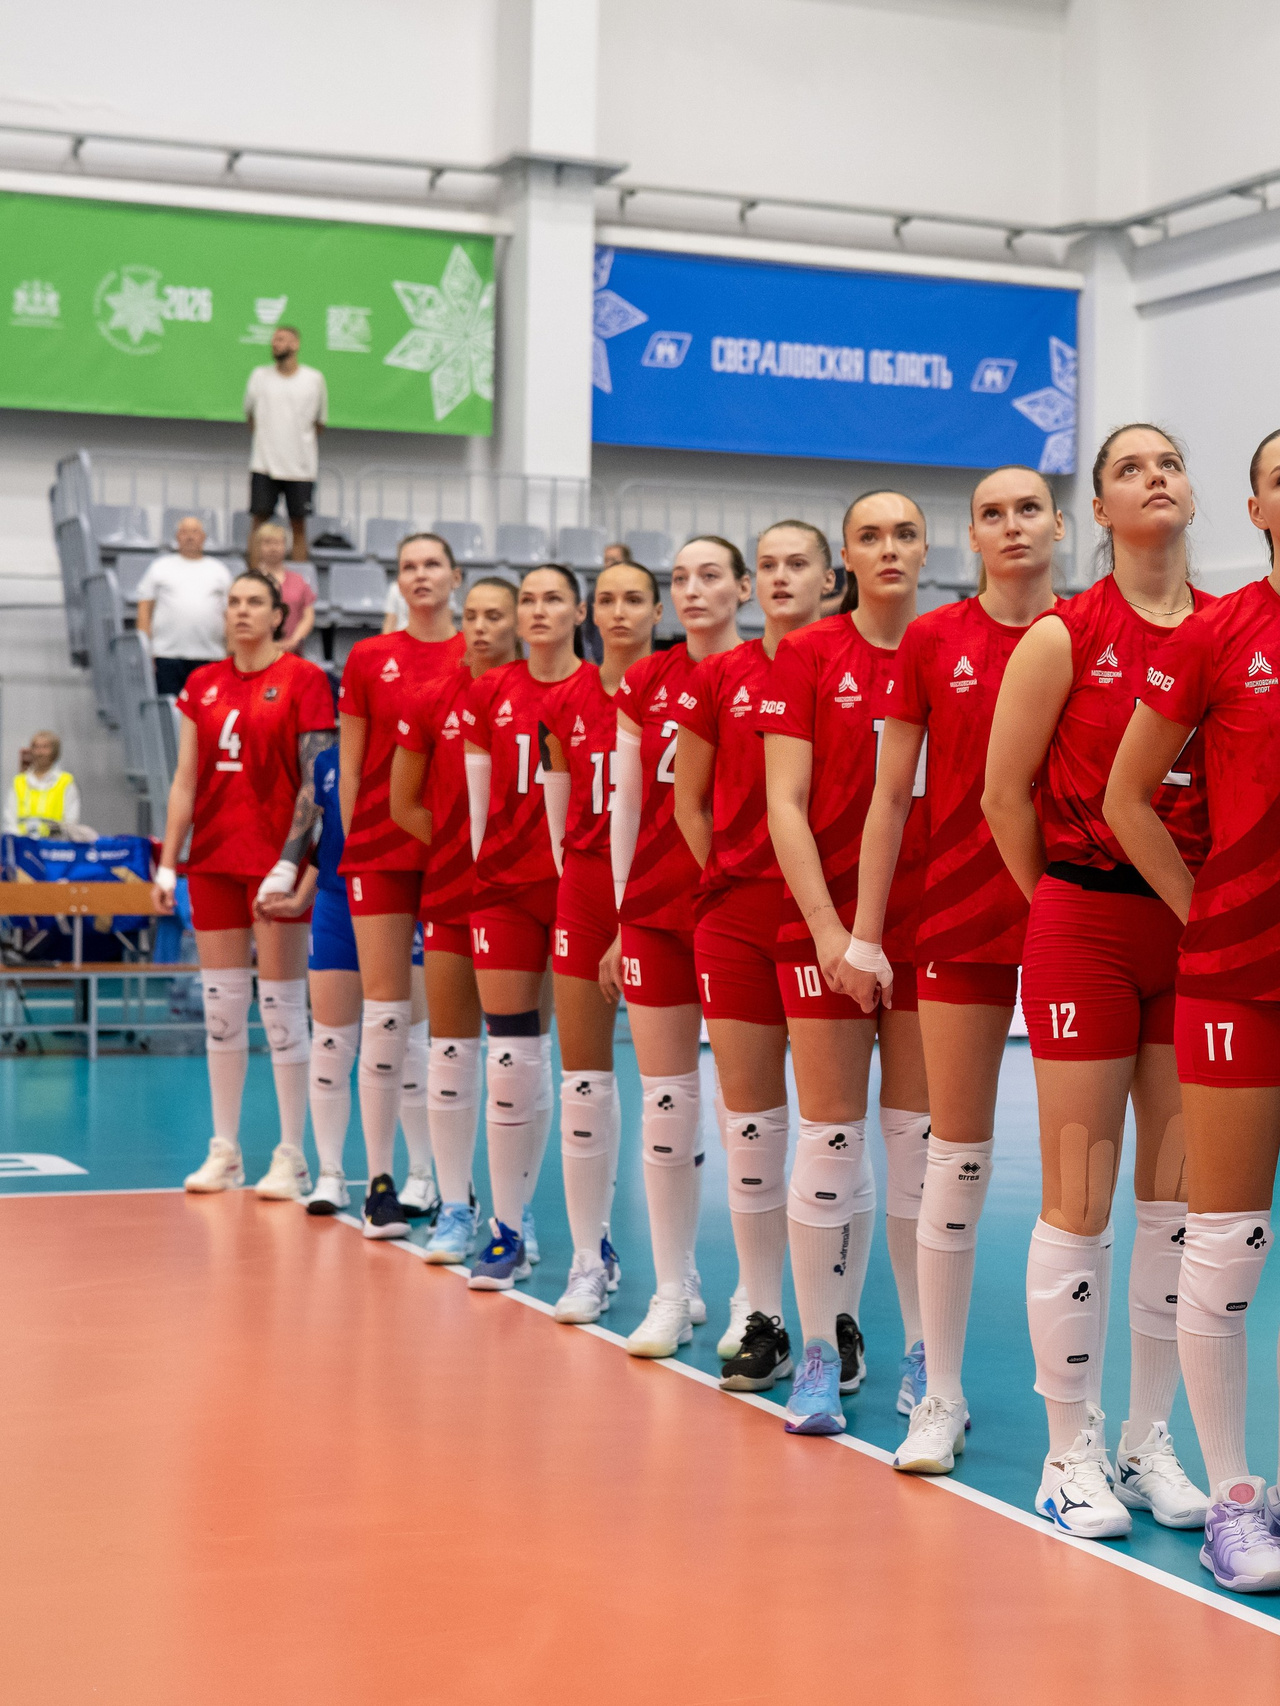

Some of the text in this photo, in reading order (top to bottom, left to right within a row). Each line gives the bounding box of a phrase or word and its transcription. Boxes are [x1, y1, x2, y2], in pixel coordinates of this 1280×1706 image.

[163, 285, 212, 322] 2026
[869, 349, 953, 389] ОБЛАСТЬ
[218, 708, 241, 759] 4
[657, 720, 679, 783] 2
[472, 927, 490, 954] 14
[555, 929, 568, 957] 15
[622, 956, 642, 986] 29
[794, 965, 822, 997] 10
[1049, 1002, 1078, 1038] 12
[1204, 1022, 1234, 1061] 17
